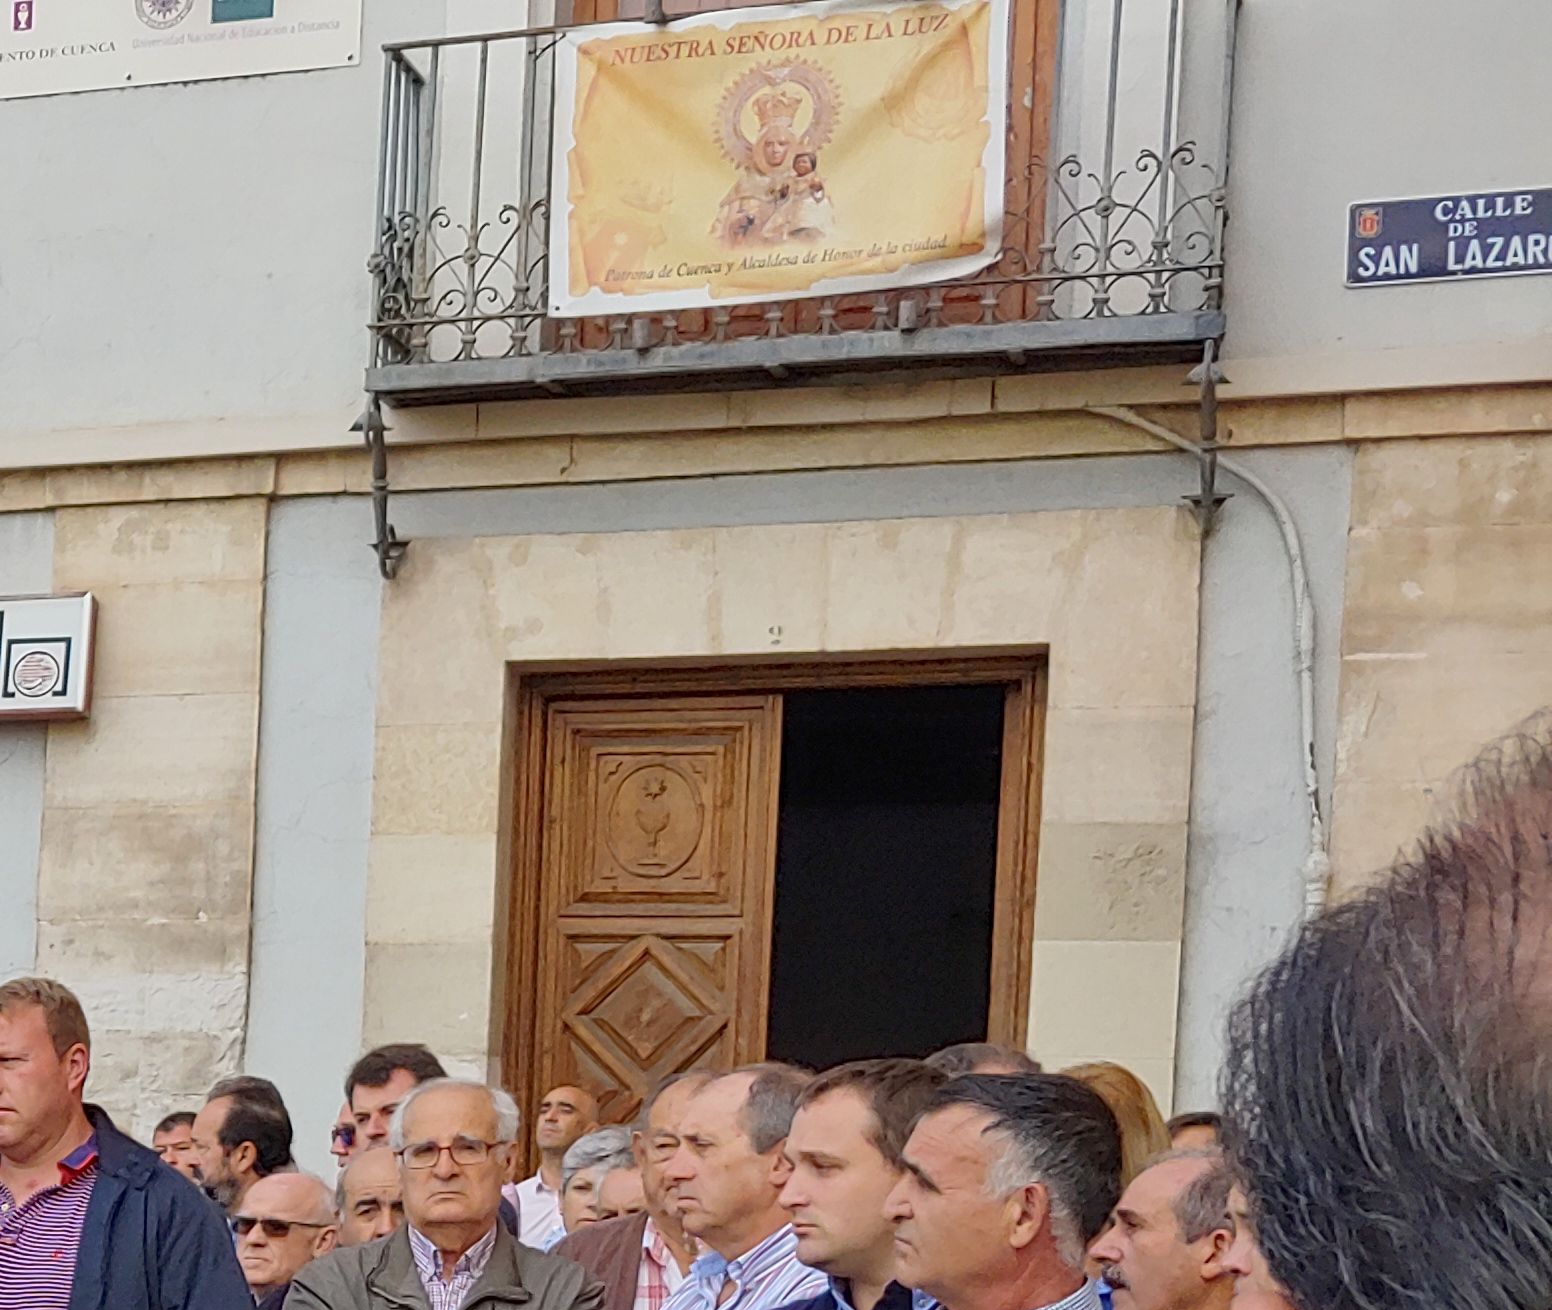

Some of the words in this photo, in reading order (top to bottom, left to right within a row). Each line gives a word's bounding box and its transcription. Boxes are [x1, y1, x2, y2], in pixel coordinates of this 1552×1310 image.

[610, 38, 717, 66] NUESTRA
[724, 27, 816, 55] SEÑORA
[824, 25, 858, 45] DE
[864, 22, 895, 41] LA
[902, 13, 949, 37] LUZ
[1434, 194, 1534, 221] CALLE
[1448, 221, 1478, 237] DE
[658, 265, 672, 279] de
[676, 261, 722, 278] Cuenca
[725, 263, 734, 277] y
[738, 254, 798, 271] Alcaldesa
[803, 251, 818, 265] de
[866, 243, 883, 258] de
[902, 235, 947, 252] ciudad
[1357, 243, 1419, 278] SAN
[1447, 233, 1552, 271] LAZAR
